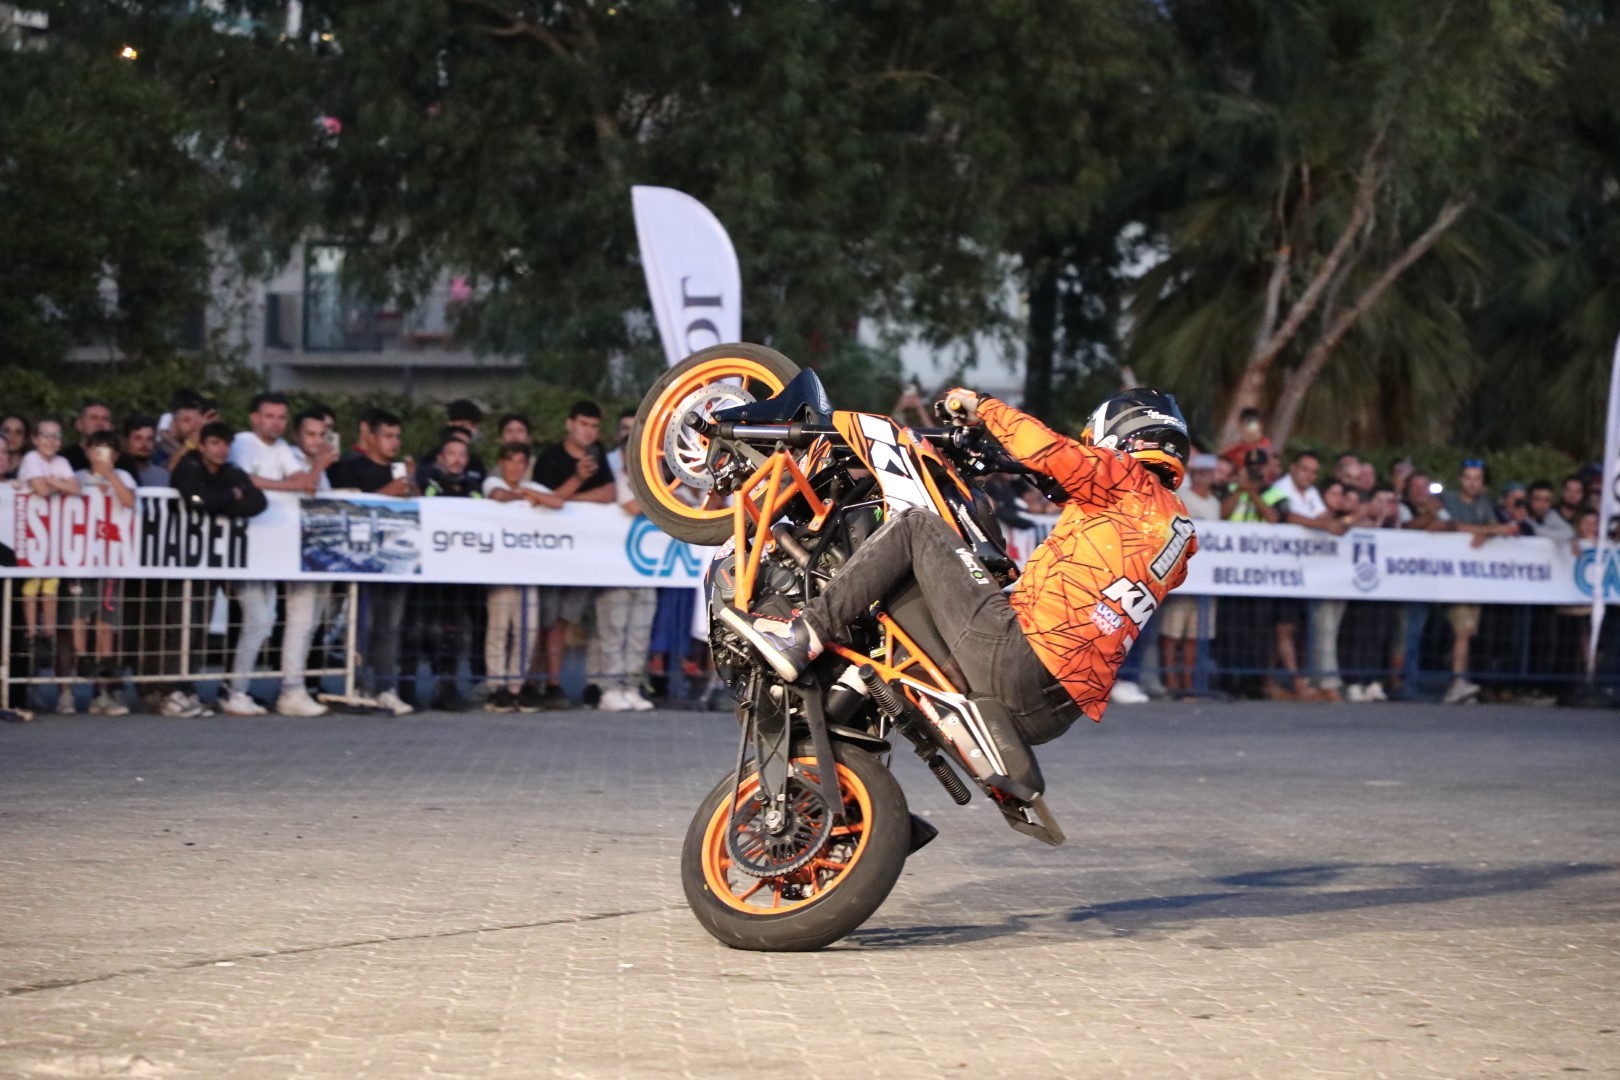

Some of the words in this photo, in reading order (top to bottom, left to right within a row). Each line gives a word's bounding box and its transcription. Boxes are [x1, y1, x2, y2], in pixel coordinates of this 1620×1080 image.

[140, 498, 248, 567] HABER
[432, 529, 494, 553] grey
[502, 528, 574, 551] beton
[1213, 564, 1304, 587] BELEDİYESİ
[1385, 556, 1455, 577] BODRUM
[1460, 558, 1553, 581] BELEDİYESİ
[1090, 611, 1117, 637] MOLY
[1096, 601, 1123, 630] LIQUI
